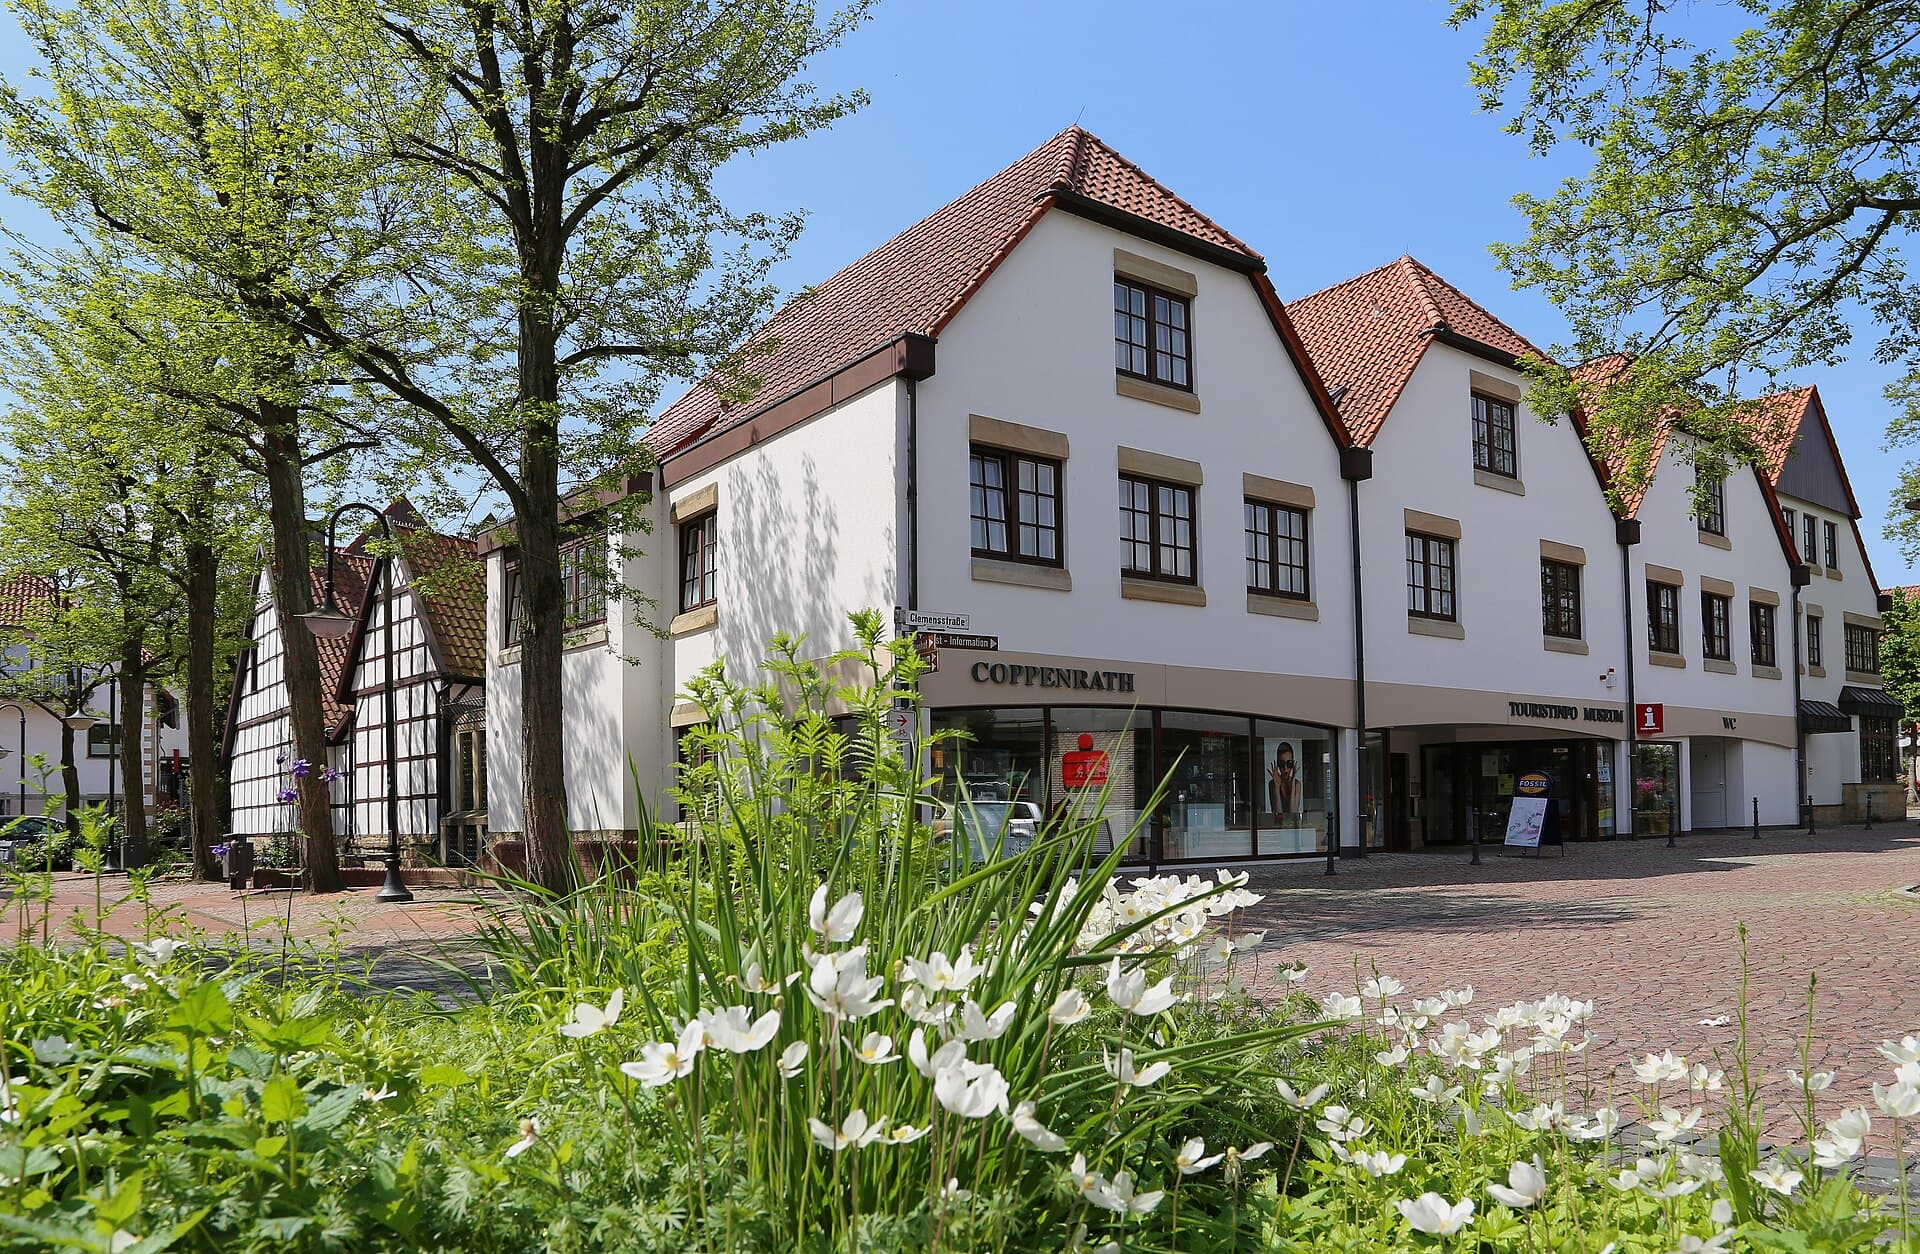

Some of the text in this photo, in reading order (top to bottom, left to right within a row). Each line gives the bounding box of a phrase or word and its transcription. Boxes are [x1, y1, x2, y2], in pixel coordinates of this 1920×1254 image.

[910, 613, 965, 626] Clemensstraße
[950, 636, 989, 648] Information
[971, 661, 1136, 692] COPPENRATH
[1509, 701, 1624, 723] TOURISTINFO MUSEUM
[1722, 716, 1737, 729] WC
